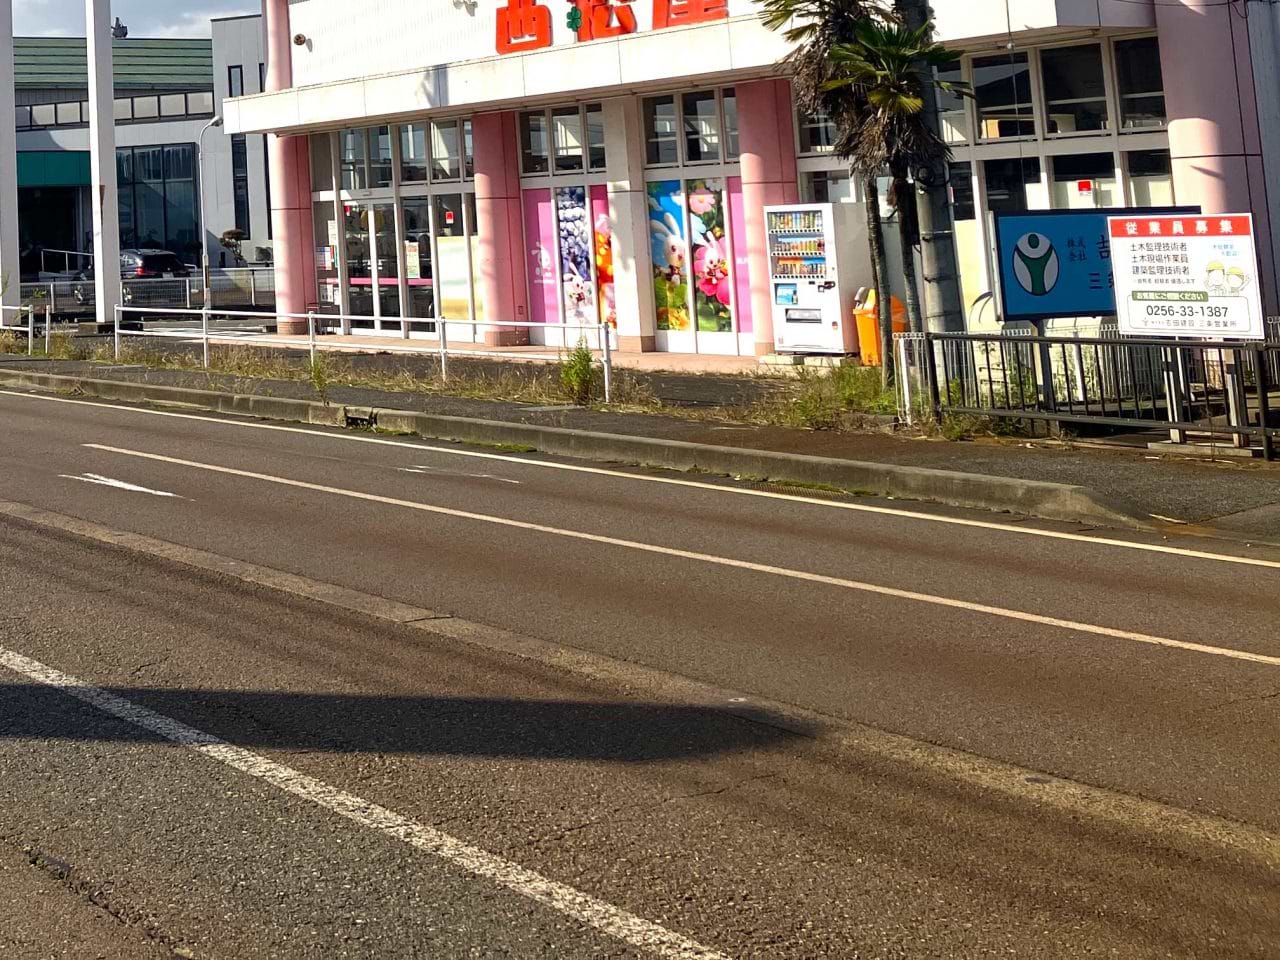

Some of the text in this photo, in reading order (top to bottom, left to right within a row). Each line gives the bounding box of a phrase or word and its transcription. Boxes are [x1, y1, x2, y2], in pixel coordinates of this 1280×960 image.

[1125, 219, 1233, 235] 従業員募集
[1146, 305, 1229, 318] 0256-33-1387
